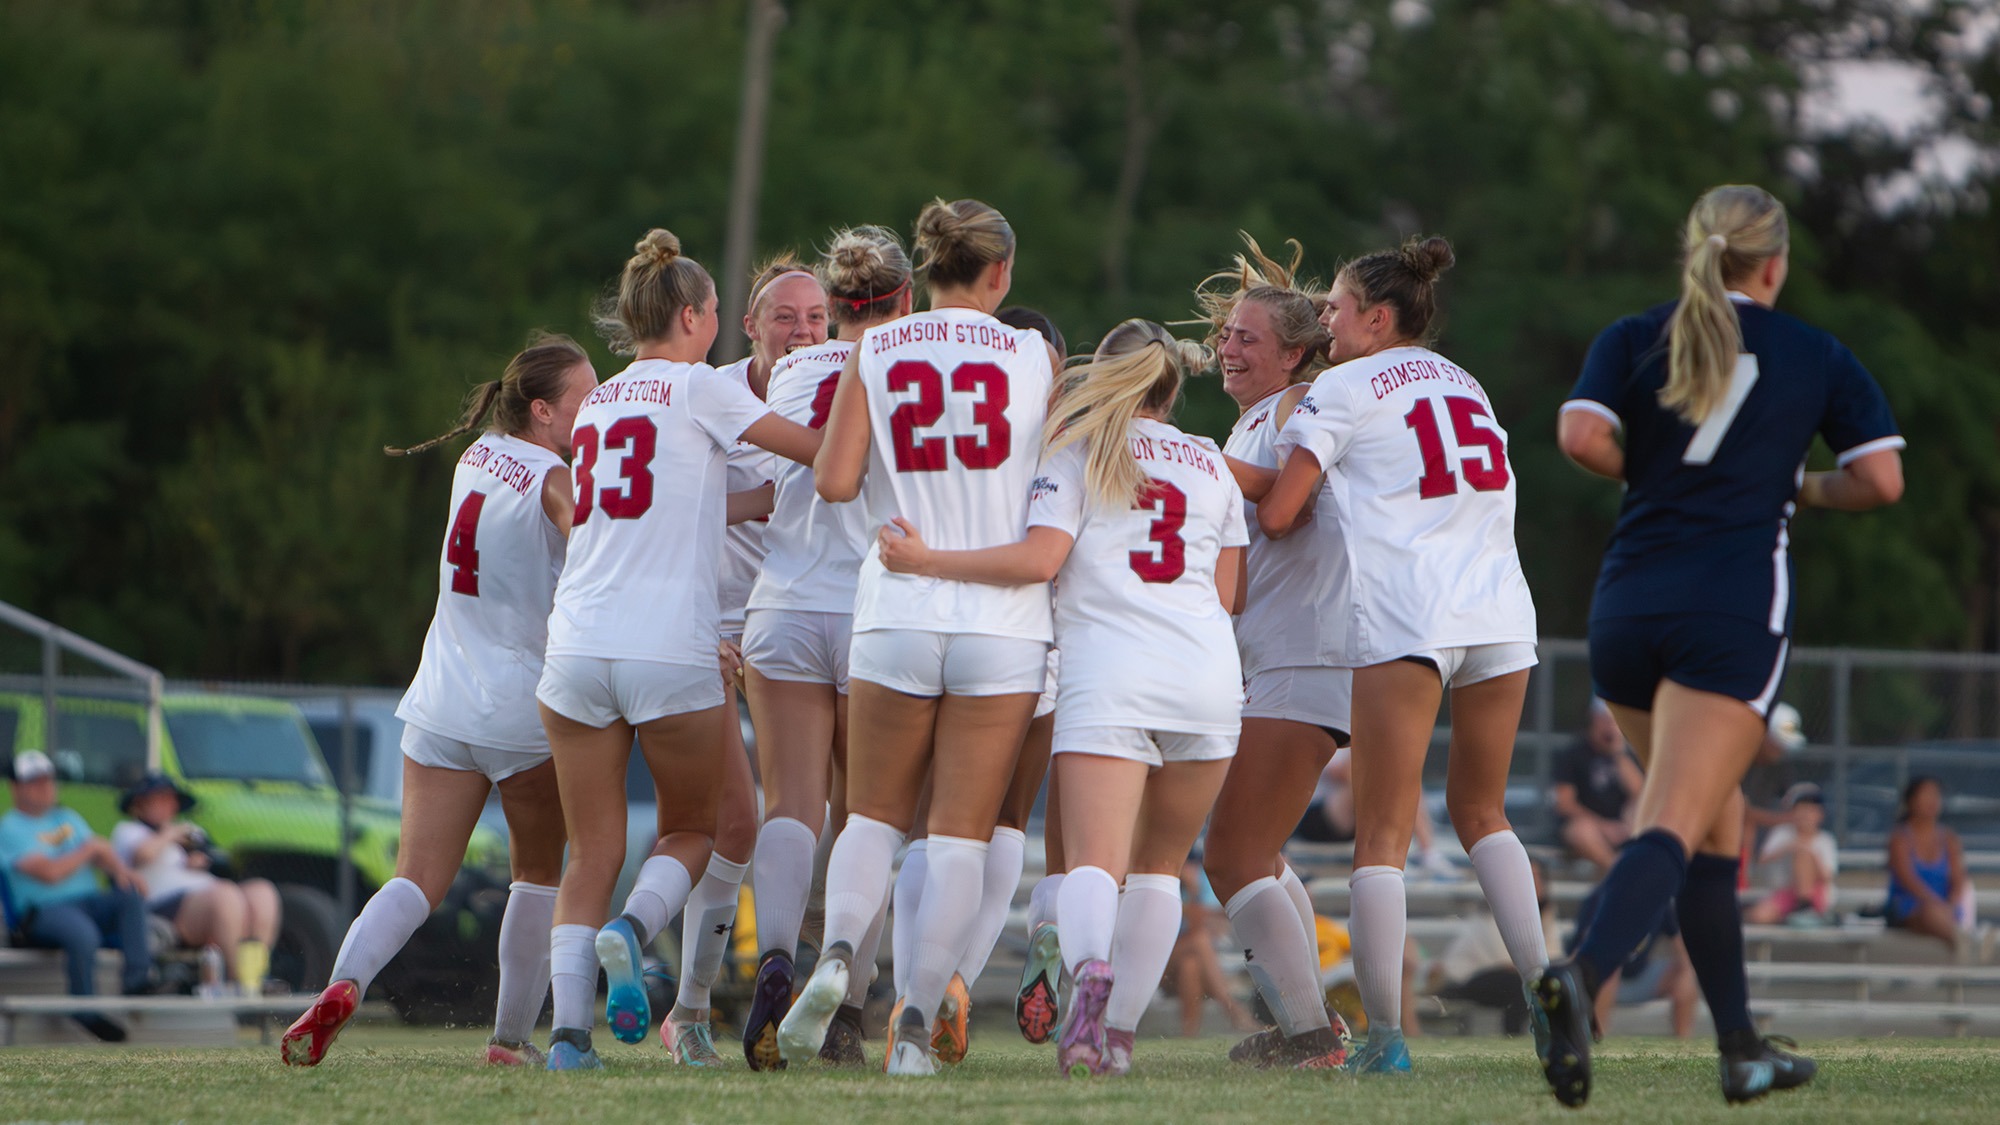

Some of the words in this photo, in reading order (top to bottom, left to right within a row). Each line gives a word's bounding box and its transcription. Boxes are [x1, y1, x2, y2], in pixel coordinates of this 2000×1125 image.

[872, 321, 949, 355] CRIMSON
[955, 323, 1018, 354] STORM
[625, 379, 672, 407] STORM
[886, 360, 1012, 473] 23
[1371, 360, 1441, 400] CRIMSON
[1441, 362, 1490, 408] STO
[488, 453, 537, 497] STORM
[571, 415, 658, 528] 33
[1160, 438, 1220, 481] STORM
[1404, 395, 1510, 500] 15
[447, 489, 487, 598] 4
[1129, 476, 1187, 584] 3
